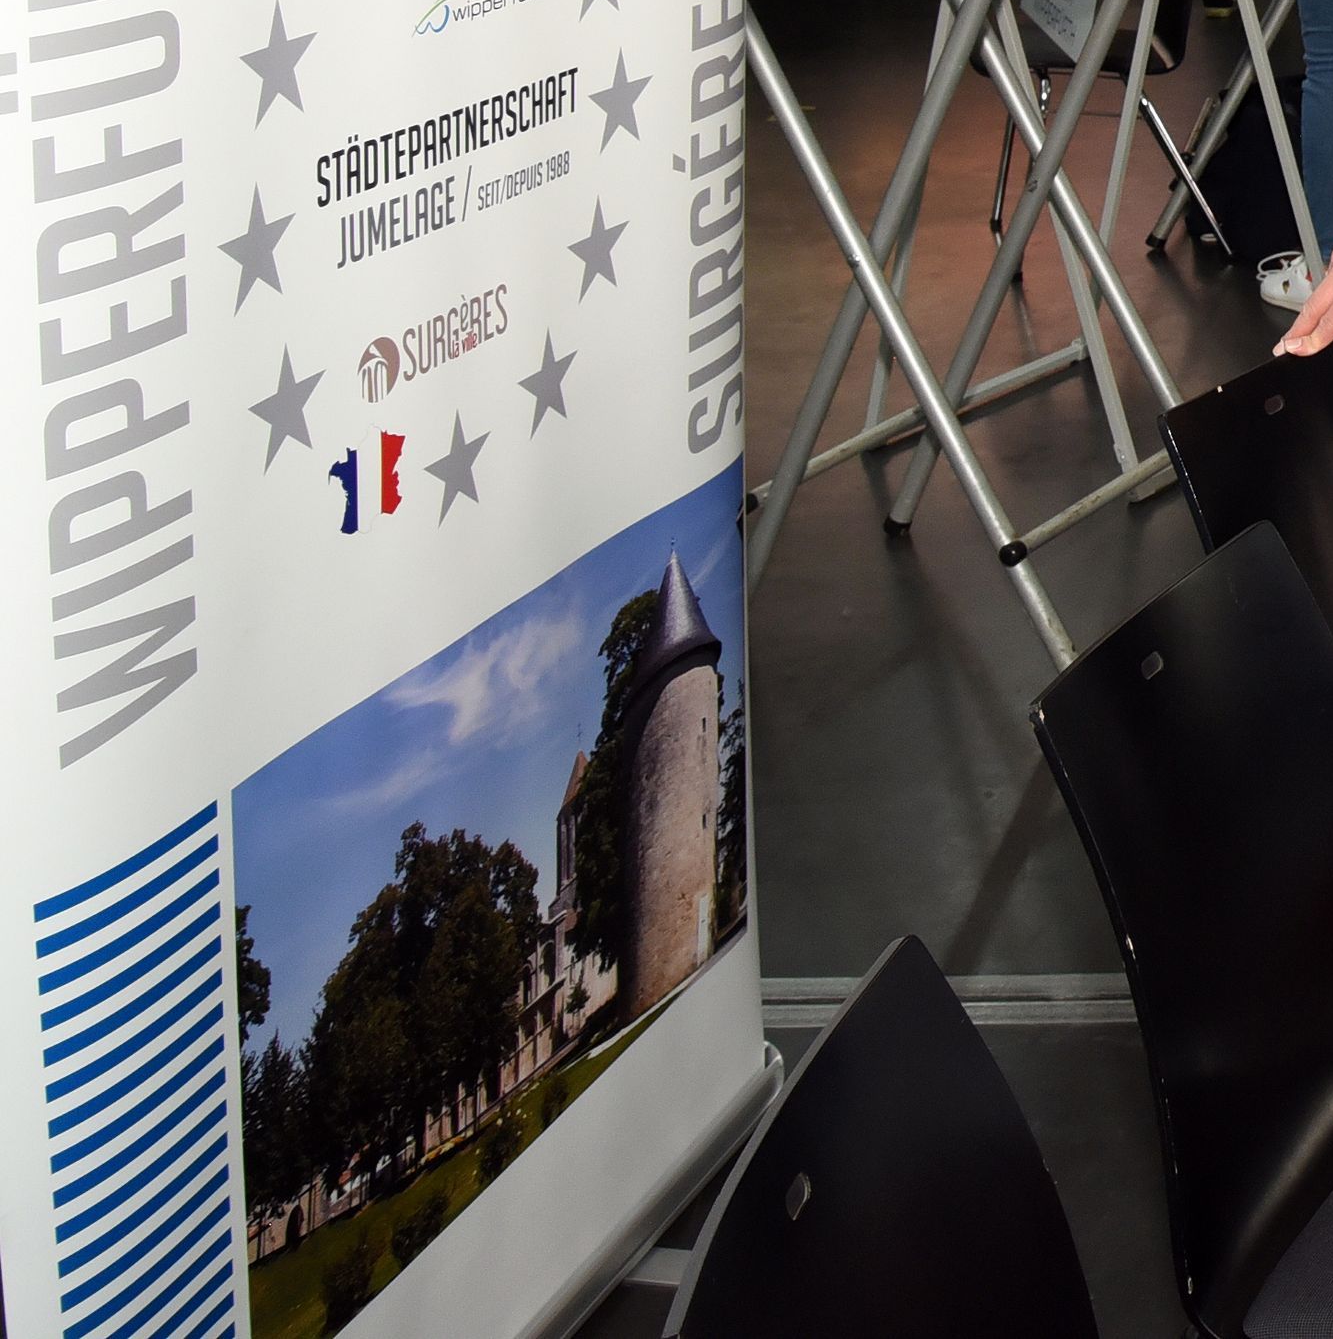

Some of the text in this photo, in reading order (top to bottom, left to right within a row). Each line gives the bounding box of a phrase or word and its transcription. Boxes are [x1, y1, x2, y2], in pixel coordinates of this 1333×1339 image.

[317, 67, 579, 208] STÄDTEPARTNERSCHAFT
[337, 176, 456, 269] JUMELAGE
[477, 161, 543, 212] SEIT/DEPUIS
[546, 150, 570, 183] 1988
